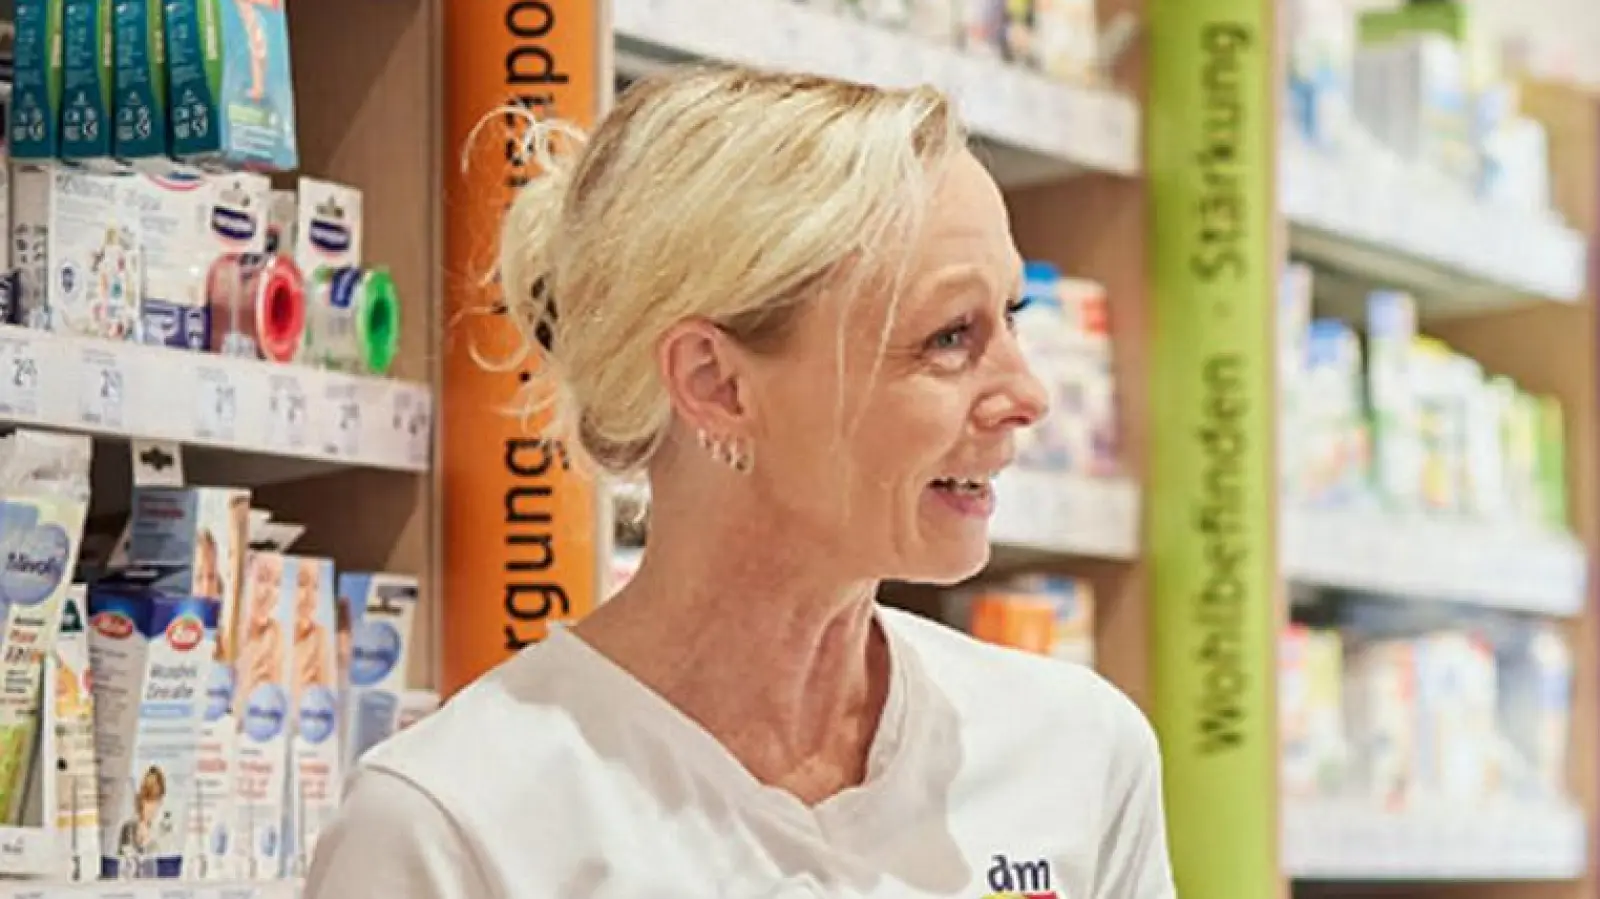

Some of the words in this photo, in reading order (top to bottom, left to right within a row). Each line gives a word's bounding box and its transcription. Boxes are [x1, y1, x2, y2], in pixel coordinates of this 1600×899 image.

[1189, 20, 1253, 283] Stärkung
[1194, 352, 1251, 755] Wohlbefinden
[987, 854, 1050, 892] dm
